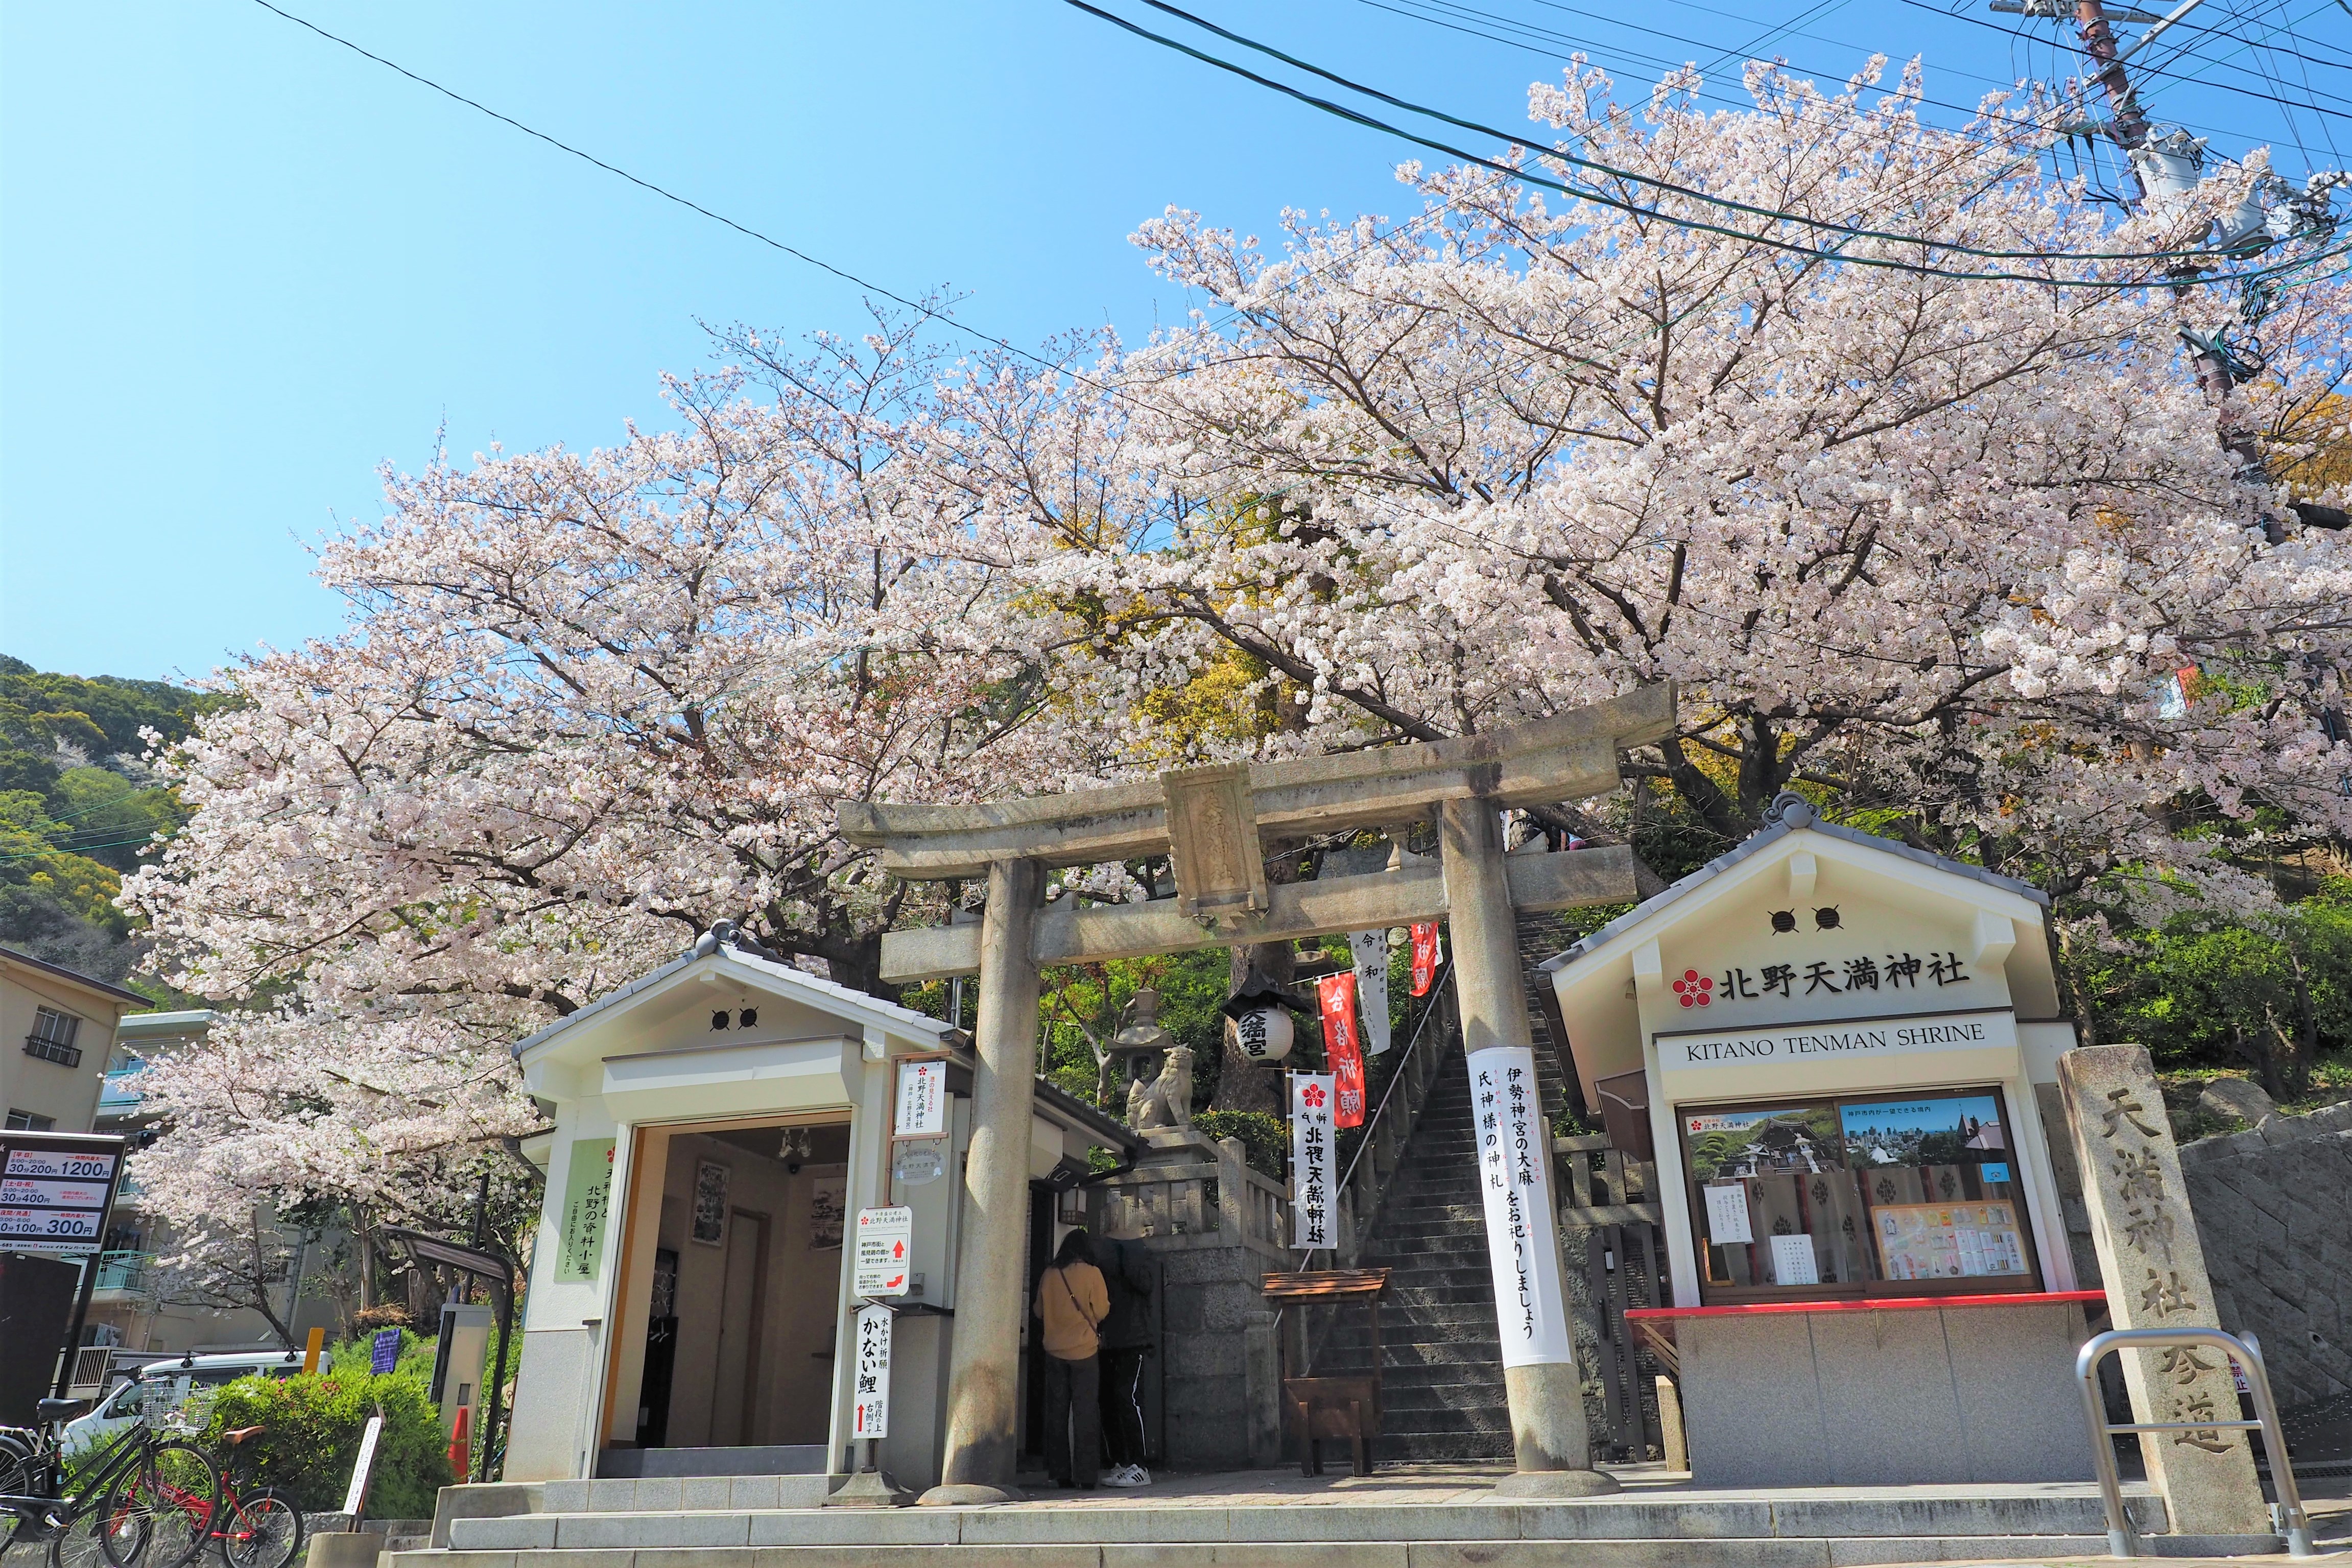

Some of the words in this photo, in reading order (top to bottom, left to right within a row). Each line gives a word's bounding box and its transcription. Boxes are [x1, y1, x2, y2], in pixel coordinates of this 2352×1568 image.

[1362, 933, 1379, 979] 令和
[1719, 952, 1970, 1000] 北野天満神社
[1686, 1039, 1774, 1062] KITANO
[1783, 1031, 1886, 1054] TENMAN
[1896, 1024, 1985, 1046] SHRINE
[915, 1077, 926, 1129] 北野天満神社
[928, 1076, 936, 1112] 港の見える社
[1847, 1106, 1931, 1117] 神戸市内が一望できる境内
[1479, 1071, 1504, 1190] 氏神様の神札
[1506, 1067, 1535, 1186] 伊勢神宮の大麻
[1704, 1121, 1750, 1130] 北野天満神社
[9, 1164, 58, 1174] 30分200円
[61, 1161, 110, 1177] 1200円
[1, 1193, 51, 1204] 30分400円
[0, 1223, 43, 1233] 0分100円
[46, 1219, 92, 1235] 300円
[564, 1201, 580, 1274] ご自由にお入りください
[577, 1185, 601, 1275] 北野の資料小屋
[869, 1216, 909, 1224] 北野天満神社
[1506, 1190, 1534, 1340] をお祀りしましょう
[858, 1317, 878, 1394] かない鯉
[878, 1317, 889, 1370] 水かけ祈願
[865, 1404, 874, 1435] 右側です
[874, 1399, 883, 1432] 階段の上
